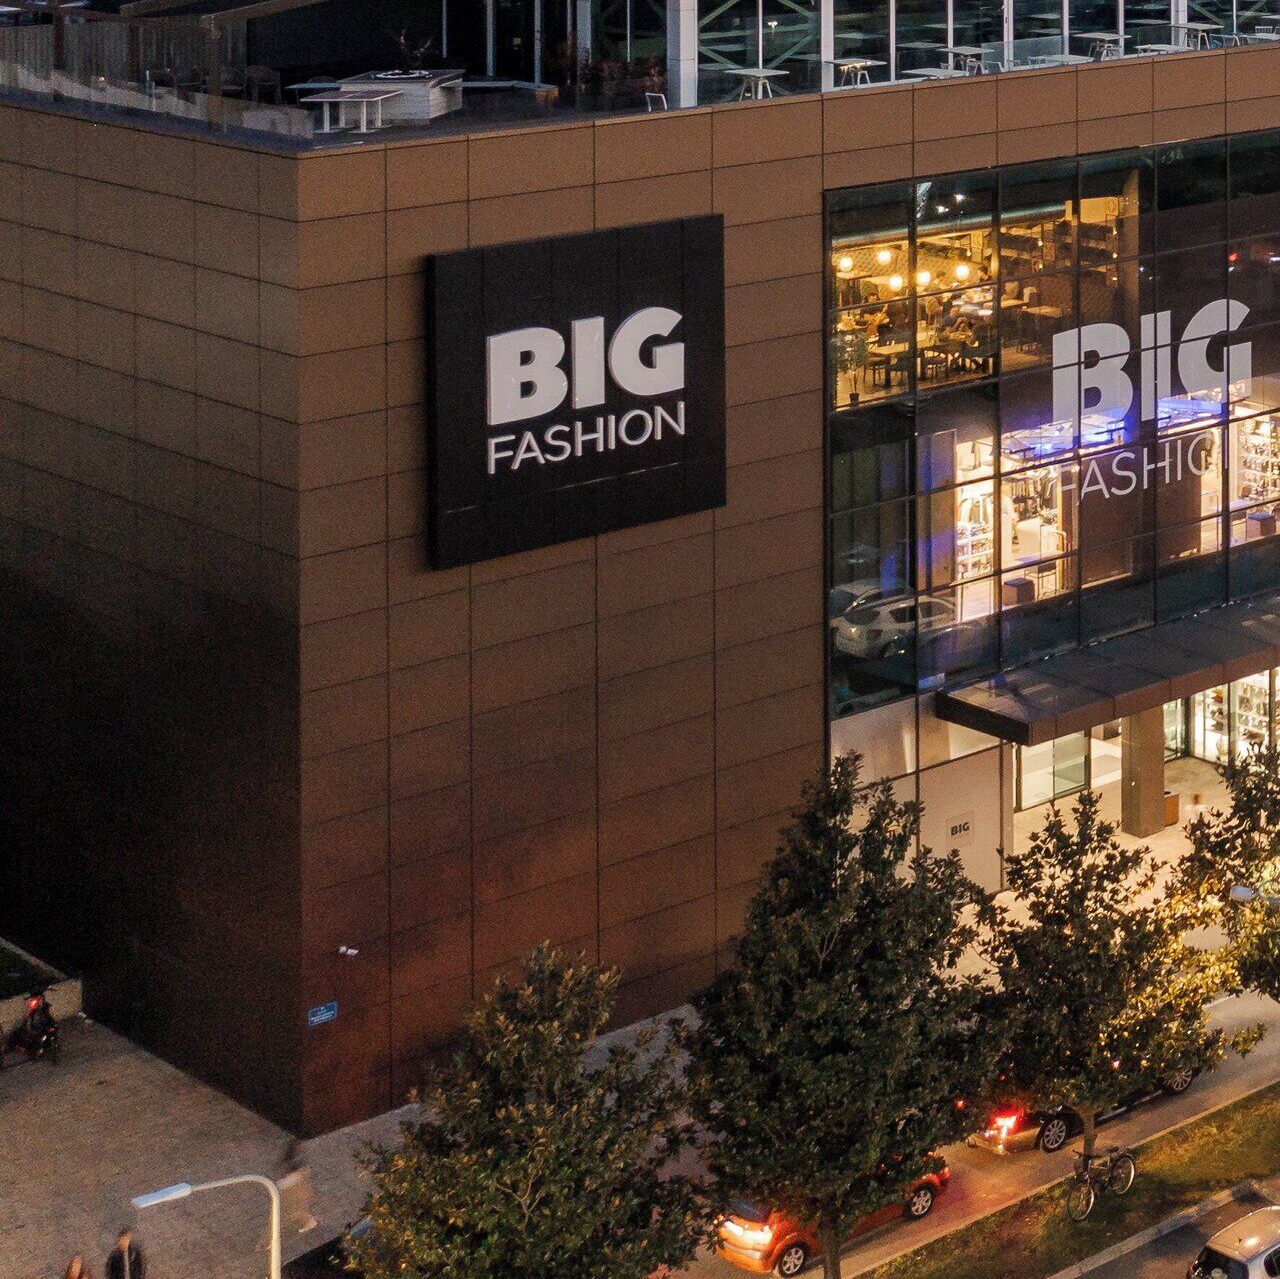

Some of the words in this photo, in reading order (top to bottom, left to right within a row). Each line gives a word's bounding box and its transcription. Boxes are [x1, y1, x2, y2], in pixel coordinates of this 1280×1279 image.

[484, 306, 685, 426] BIG
[1052, 298, 1252, 443] BIG
[486, 400, 685, 475] FASHION
[950, 821, 970, 837] BIG
